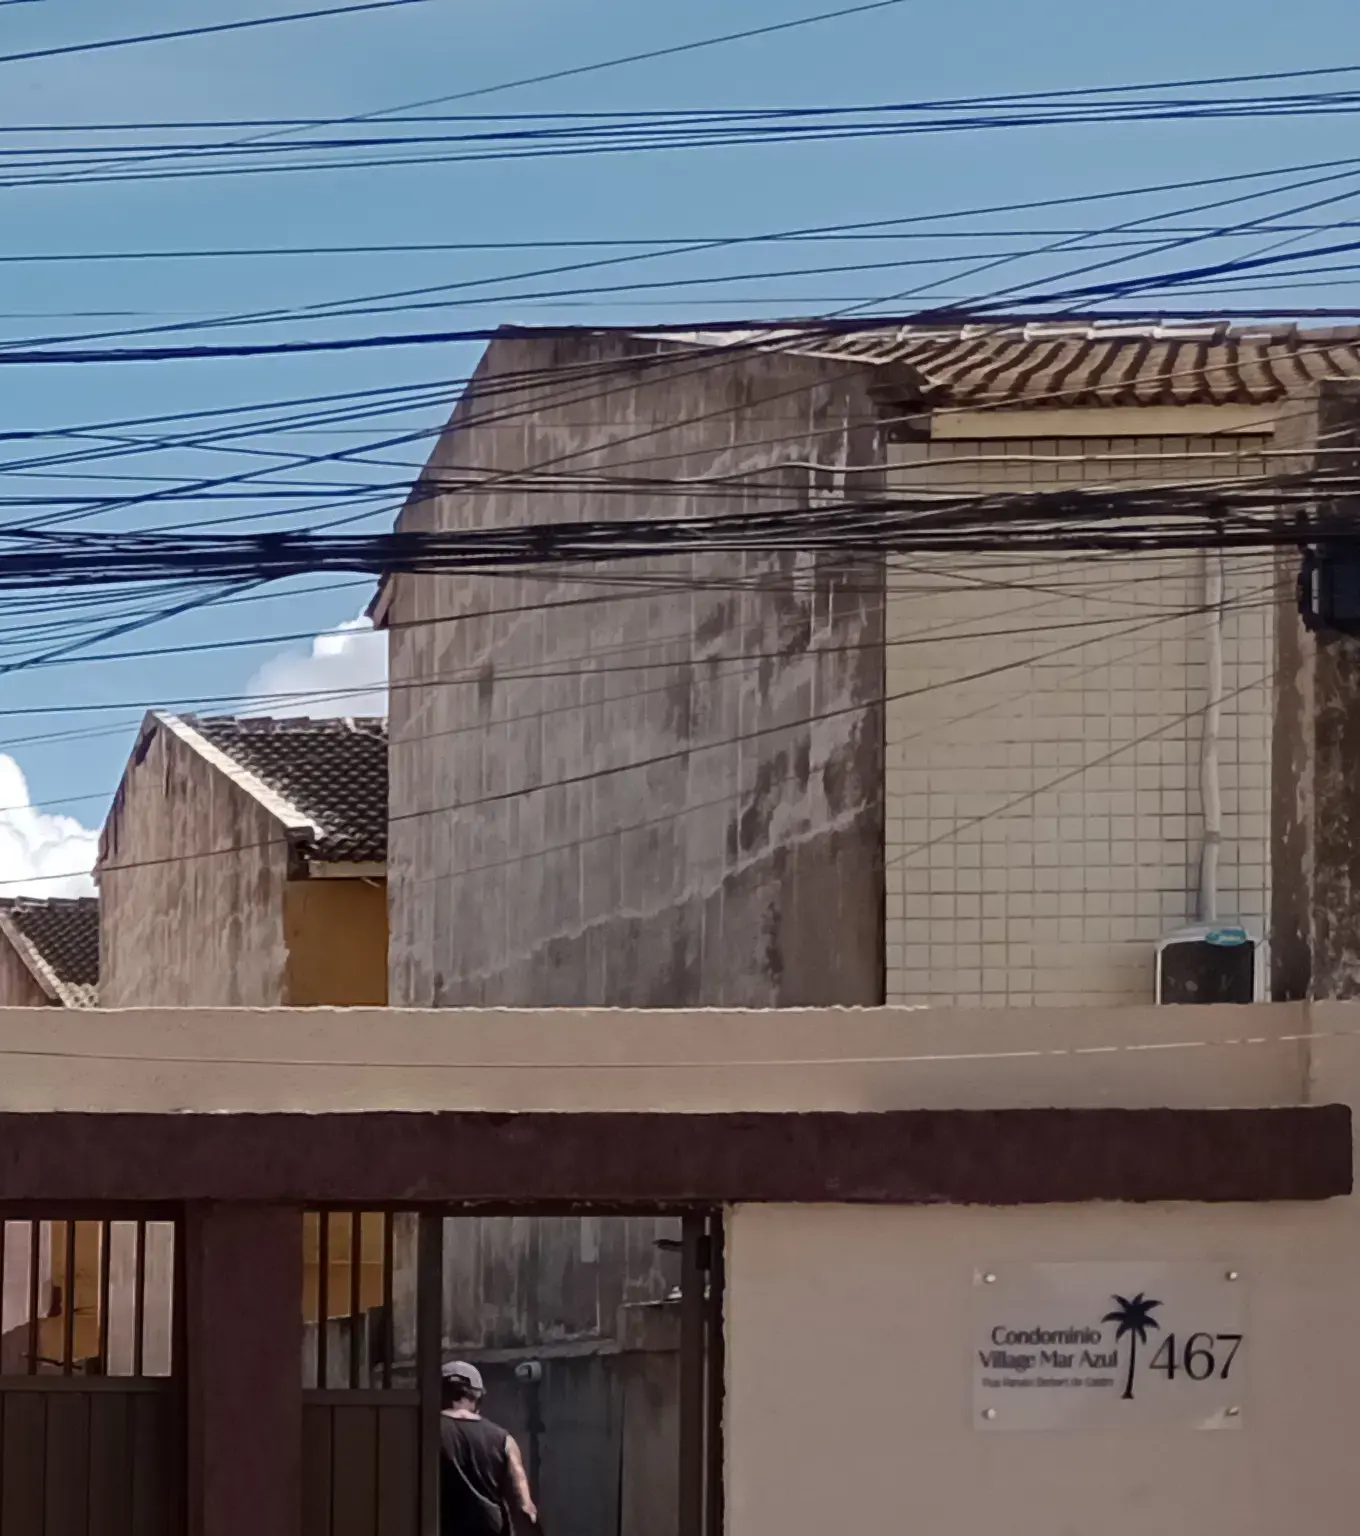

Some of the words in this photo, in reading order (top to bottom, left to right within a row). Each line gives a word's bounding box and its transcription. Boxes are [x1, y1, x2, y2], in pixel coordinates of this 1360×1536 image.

[1040, 1350, 1074, 1368] Mar
[1079, 1349, 1118, 1368] Azul
[1148, 1332, 1243, 1380] 467
